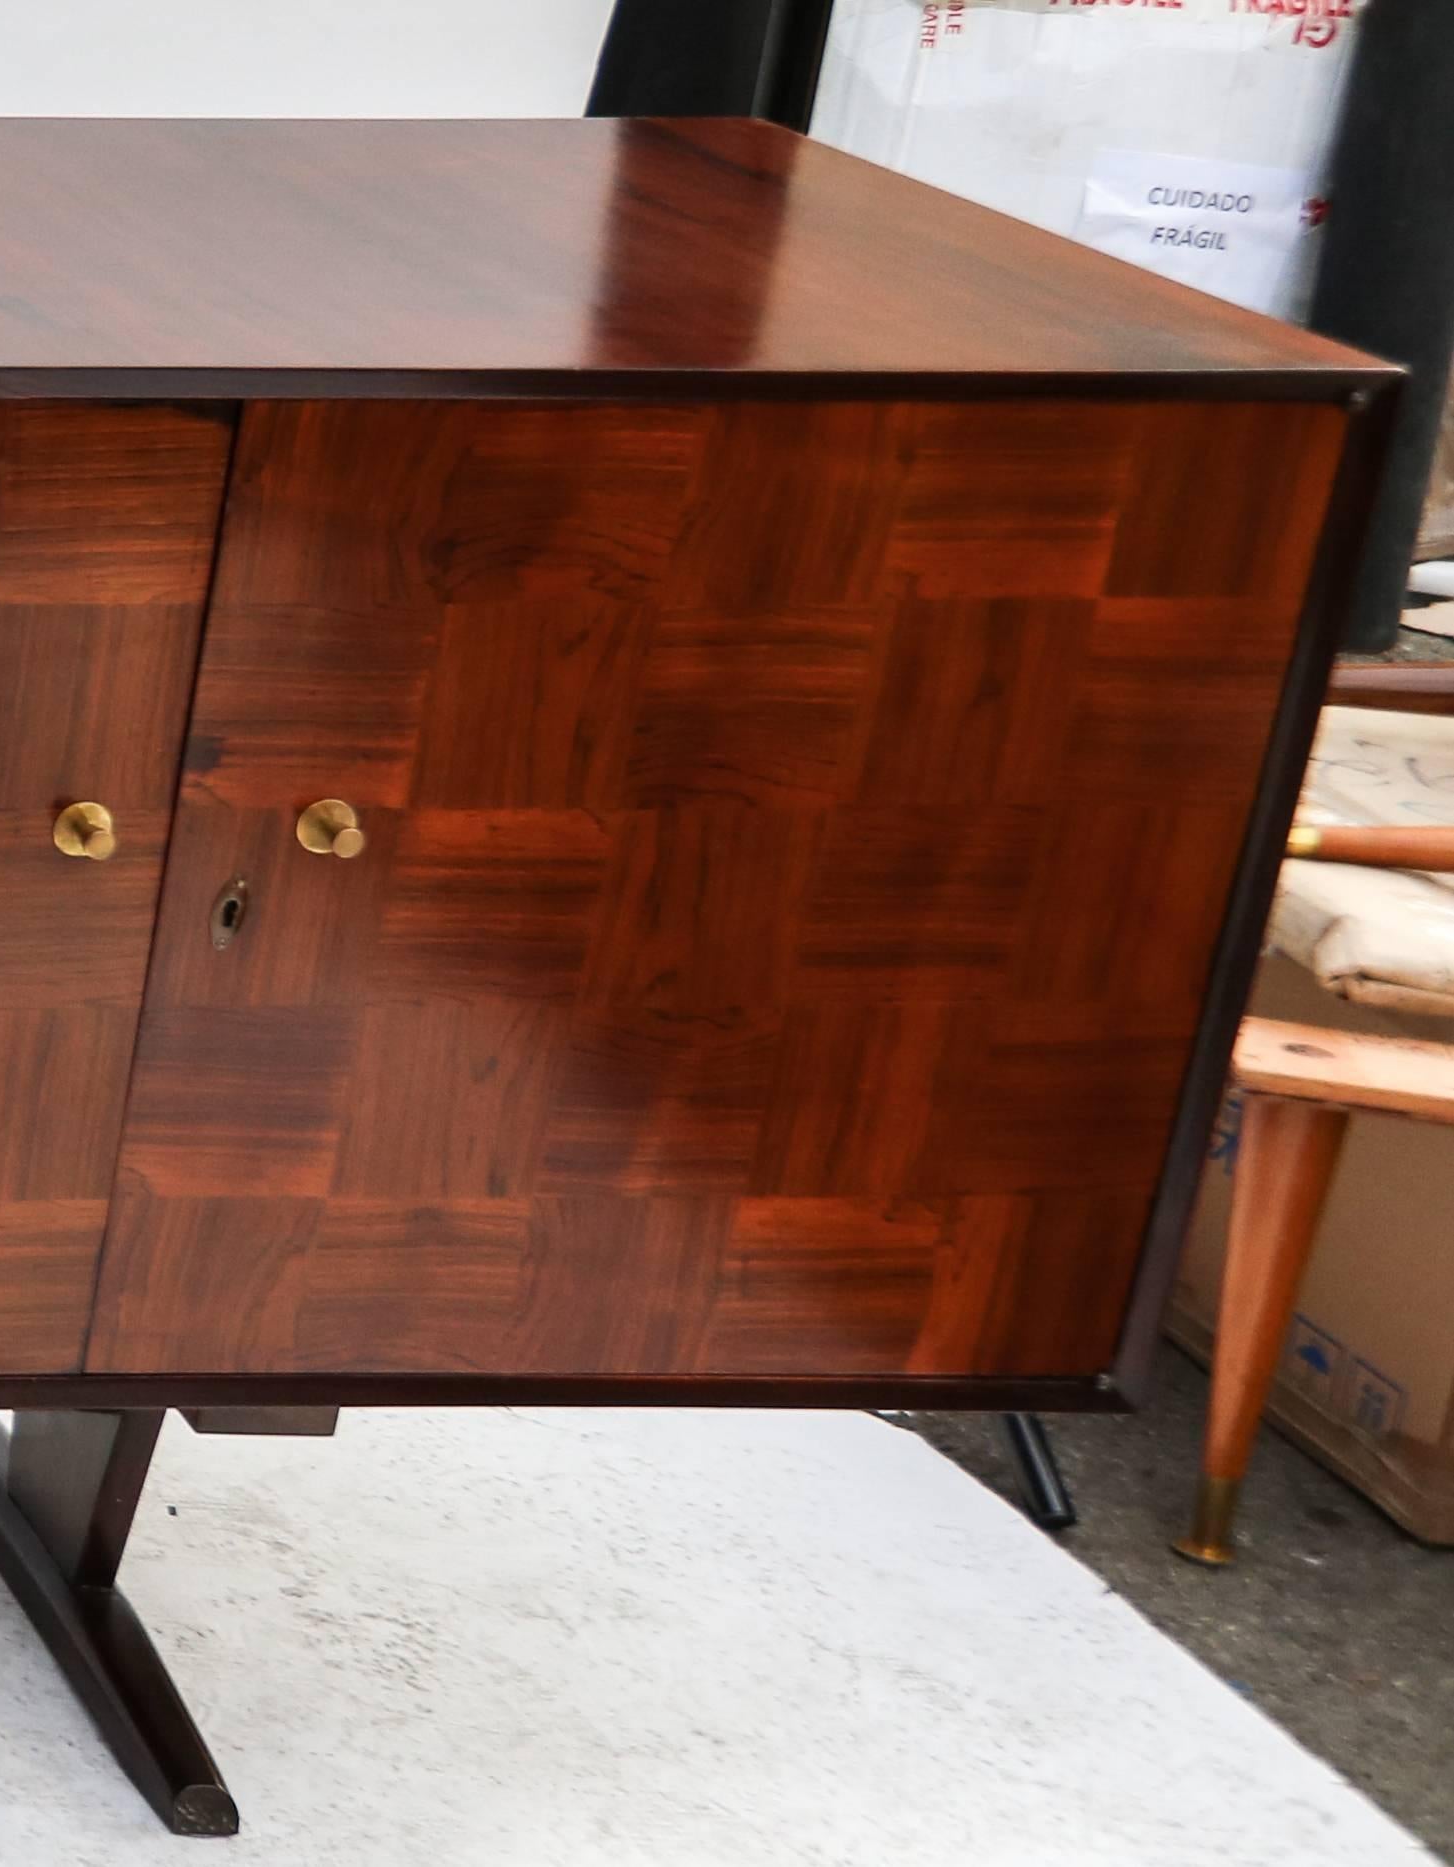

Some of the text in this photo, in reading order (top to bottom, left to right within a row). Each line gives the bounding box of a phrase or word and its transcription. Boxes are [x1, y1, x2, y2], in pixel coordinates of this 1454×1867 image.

[920, 4, 937, 49] CARE
[1147, 186, 1252, 213] CUIDADO
[1150, 224, 1228, 251] FRÁGIL
